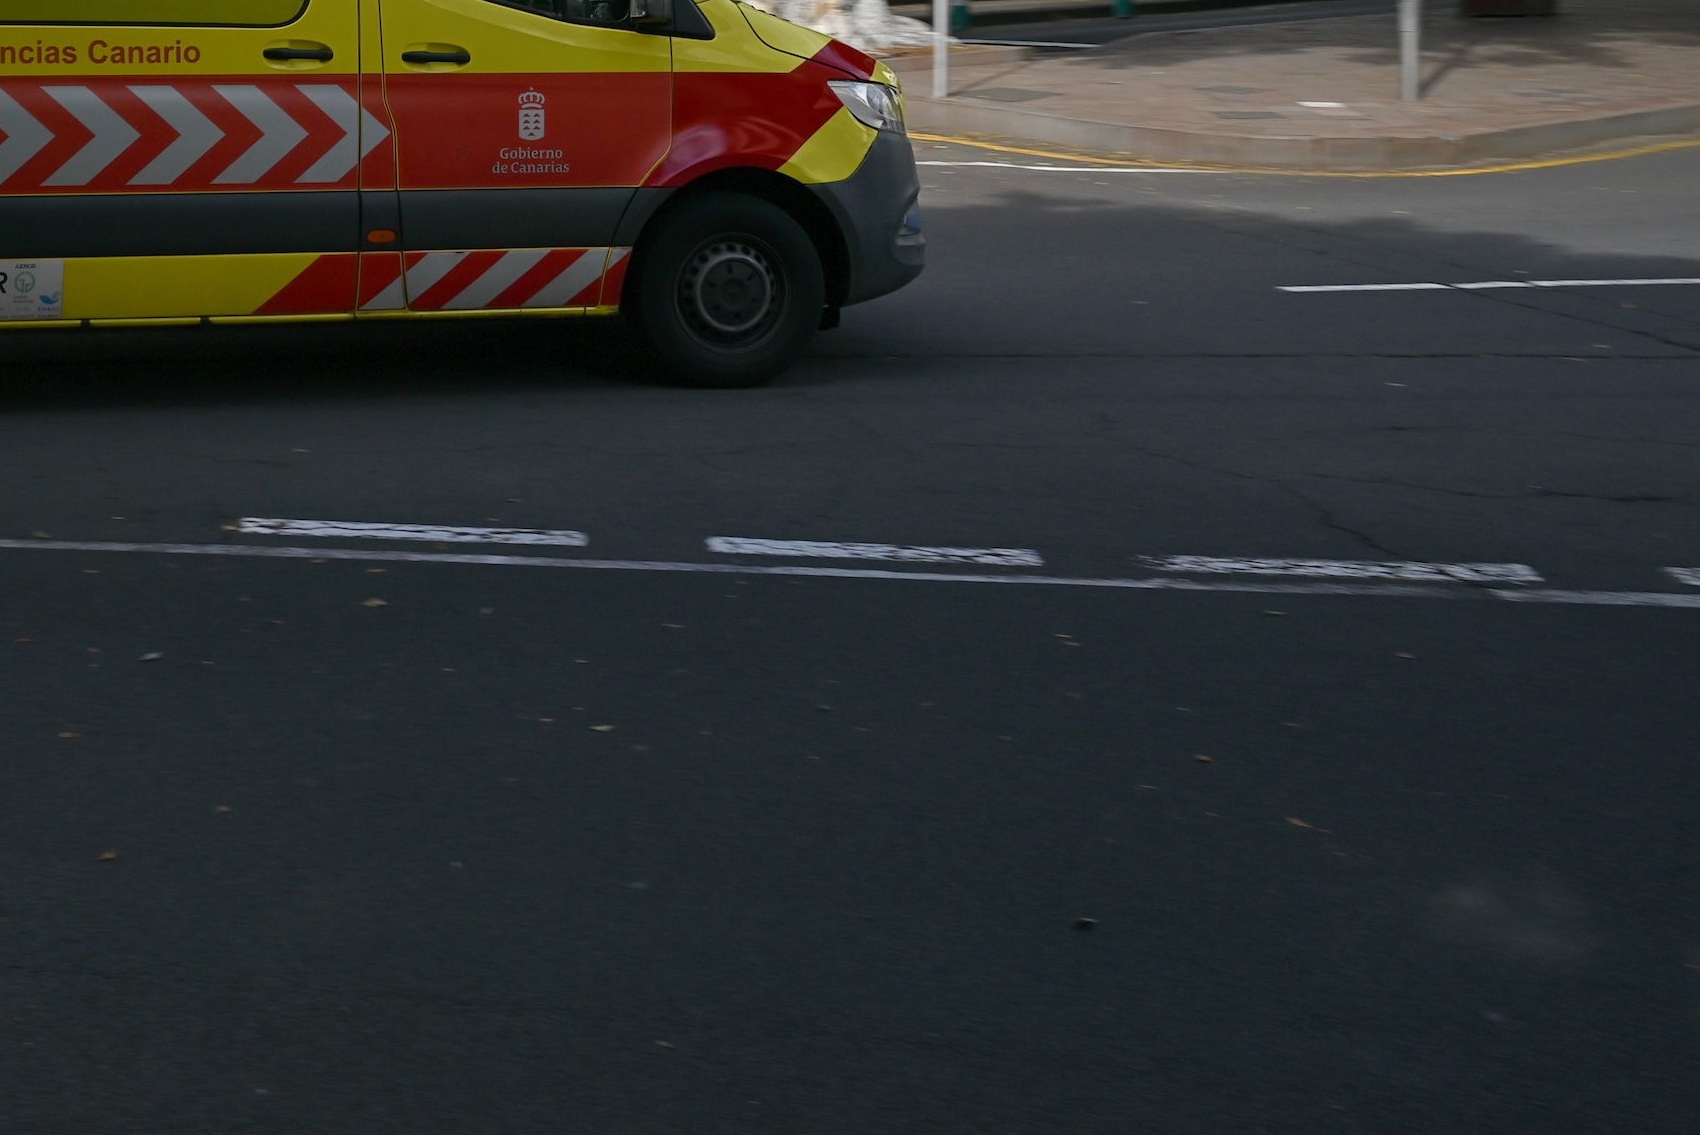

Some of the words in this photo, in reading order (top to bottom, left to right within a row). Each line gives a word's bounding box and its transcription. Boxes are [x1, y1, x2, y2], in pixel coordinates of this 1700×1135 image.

[87, 40, 201, 65] Canario
[499, 147, 563, 159] Gobierno
[492, 161, 508, 174] de
[511, 161, 570, 174] Canarias
